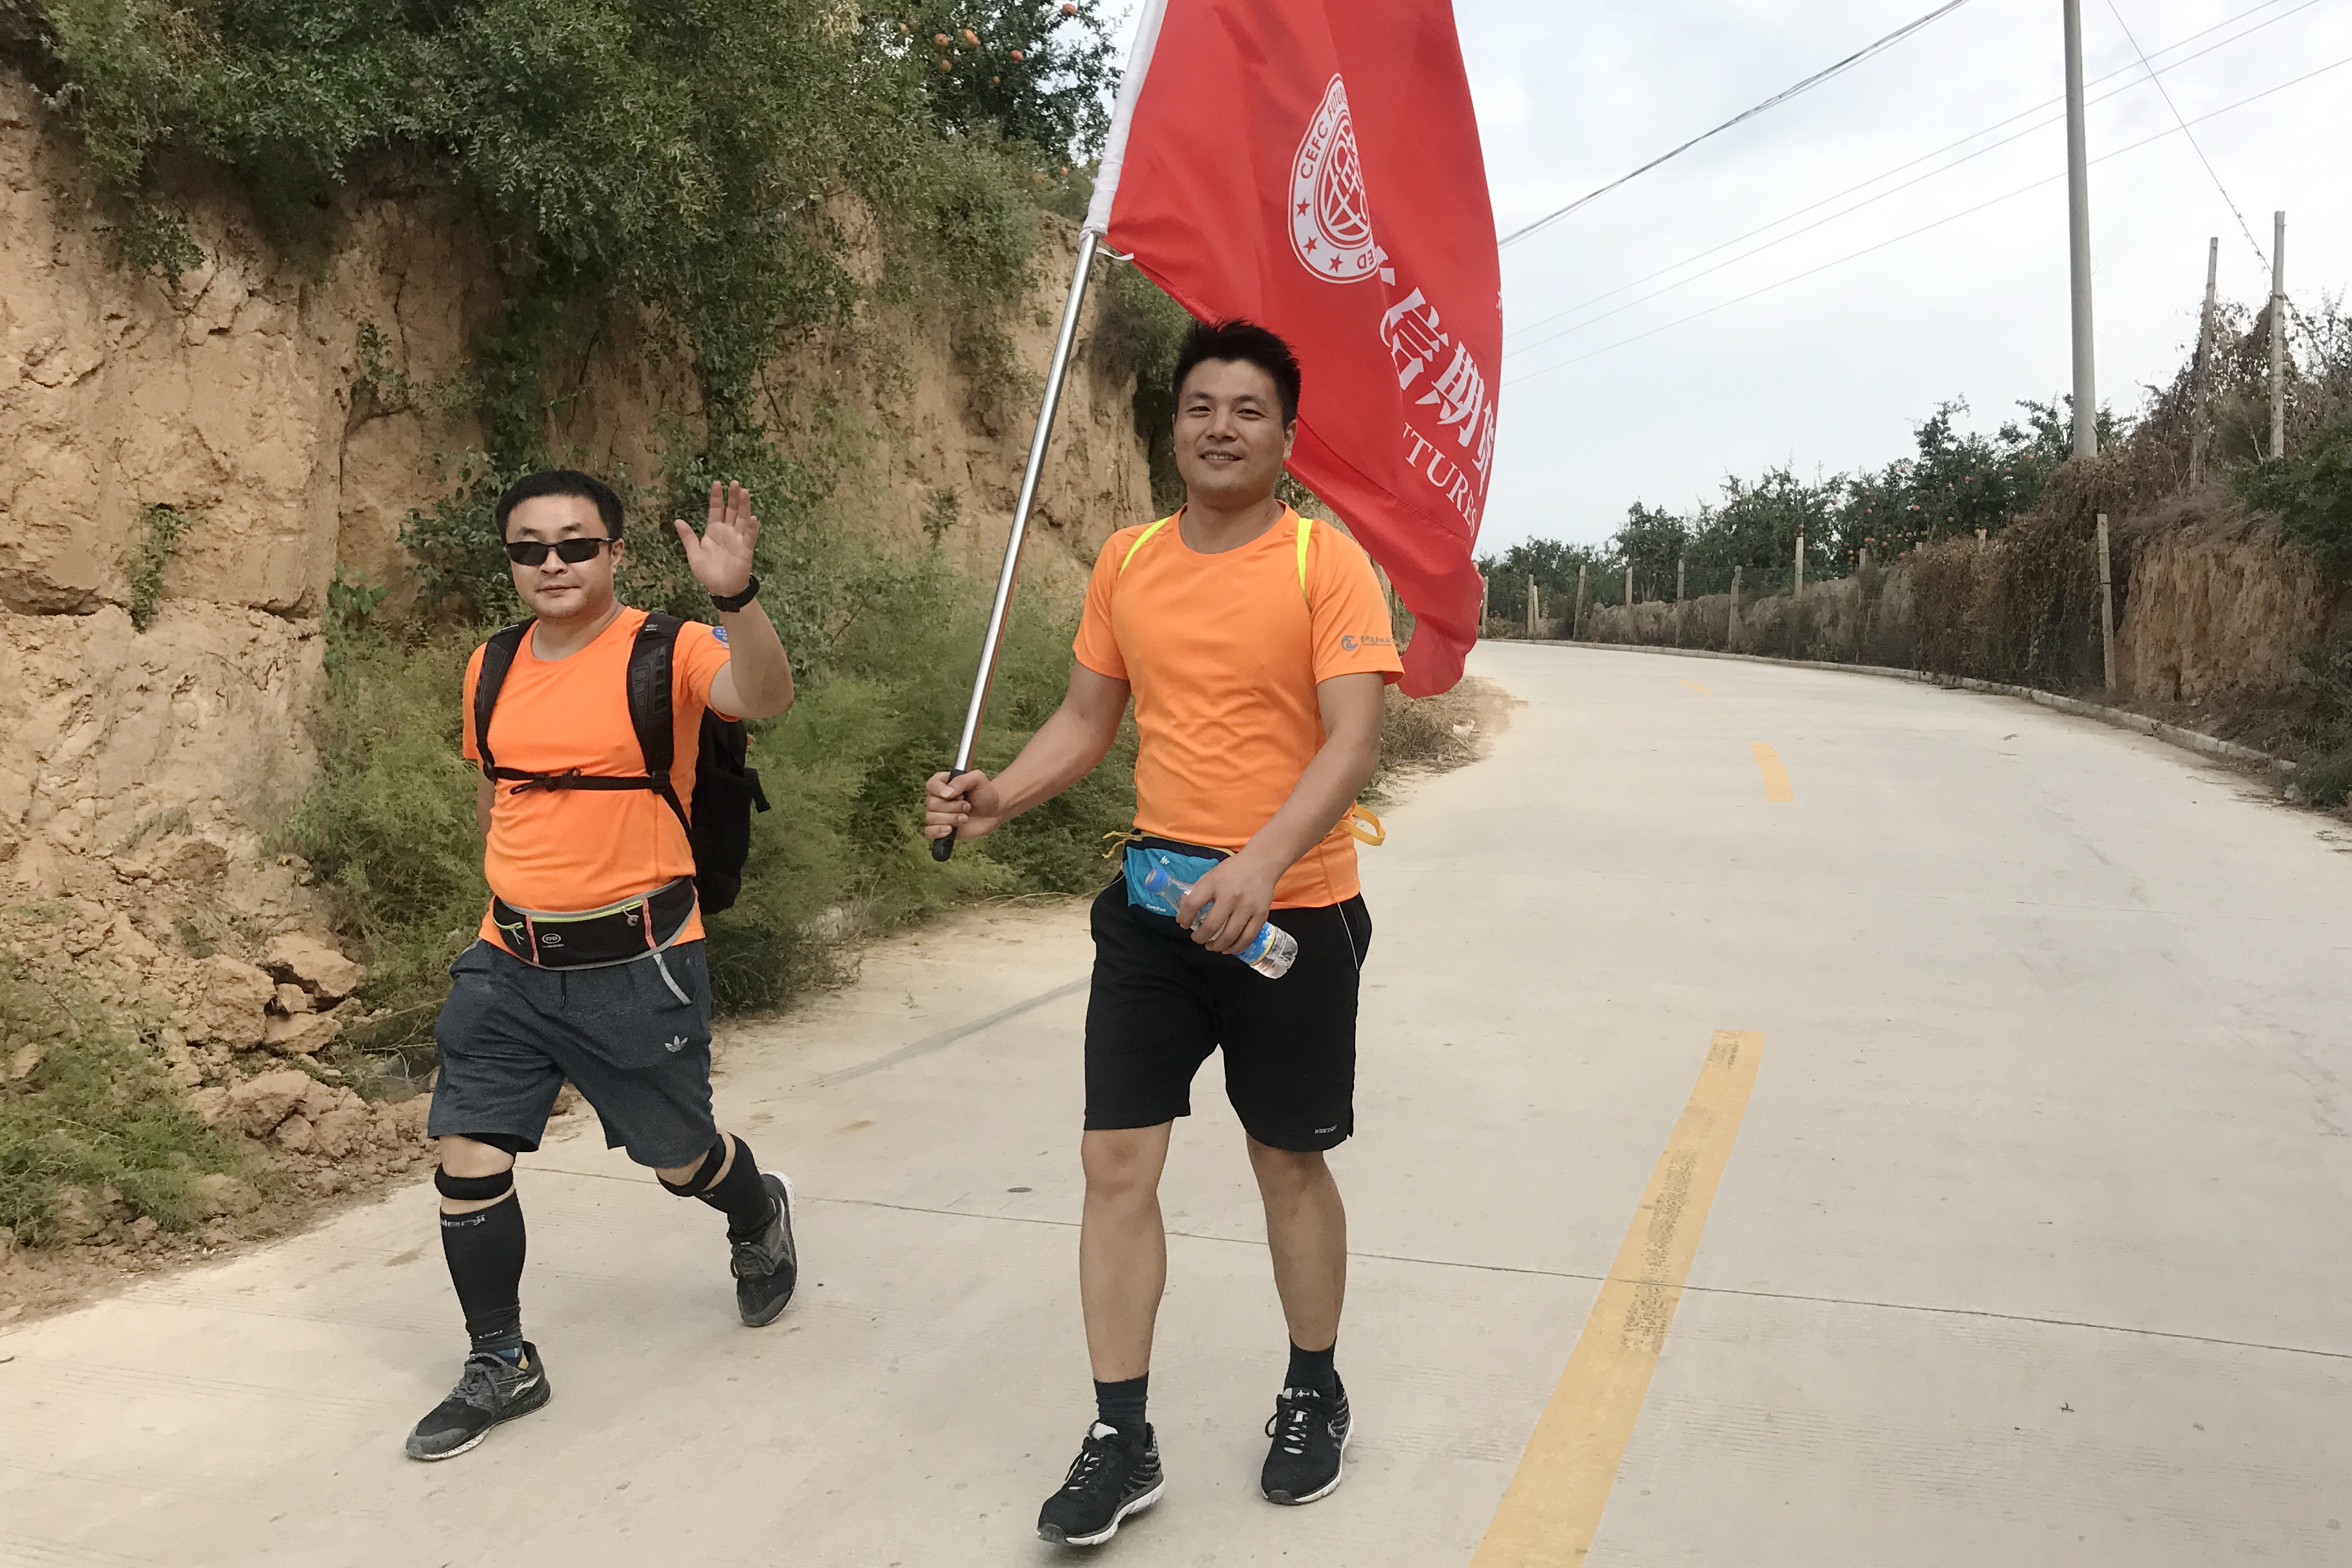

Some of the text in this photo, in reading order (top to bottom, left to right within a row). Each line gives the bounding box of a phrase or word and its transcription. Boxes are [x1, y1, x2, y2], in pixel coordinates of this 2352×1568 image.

[1300, 121, 1328, 179] CEFC
[1357, 249, 1375, 270] ED
[1402, 421, 1477, 537] TURES
